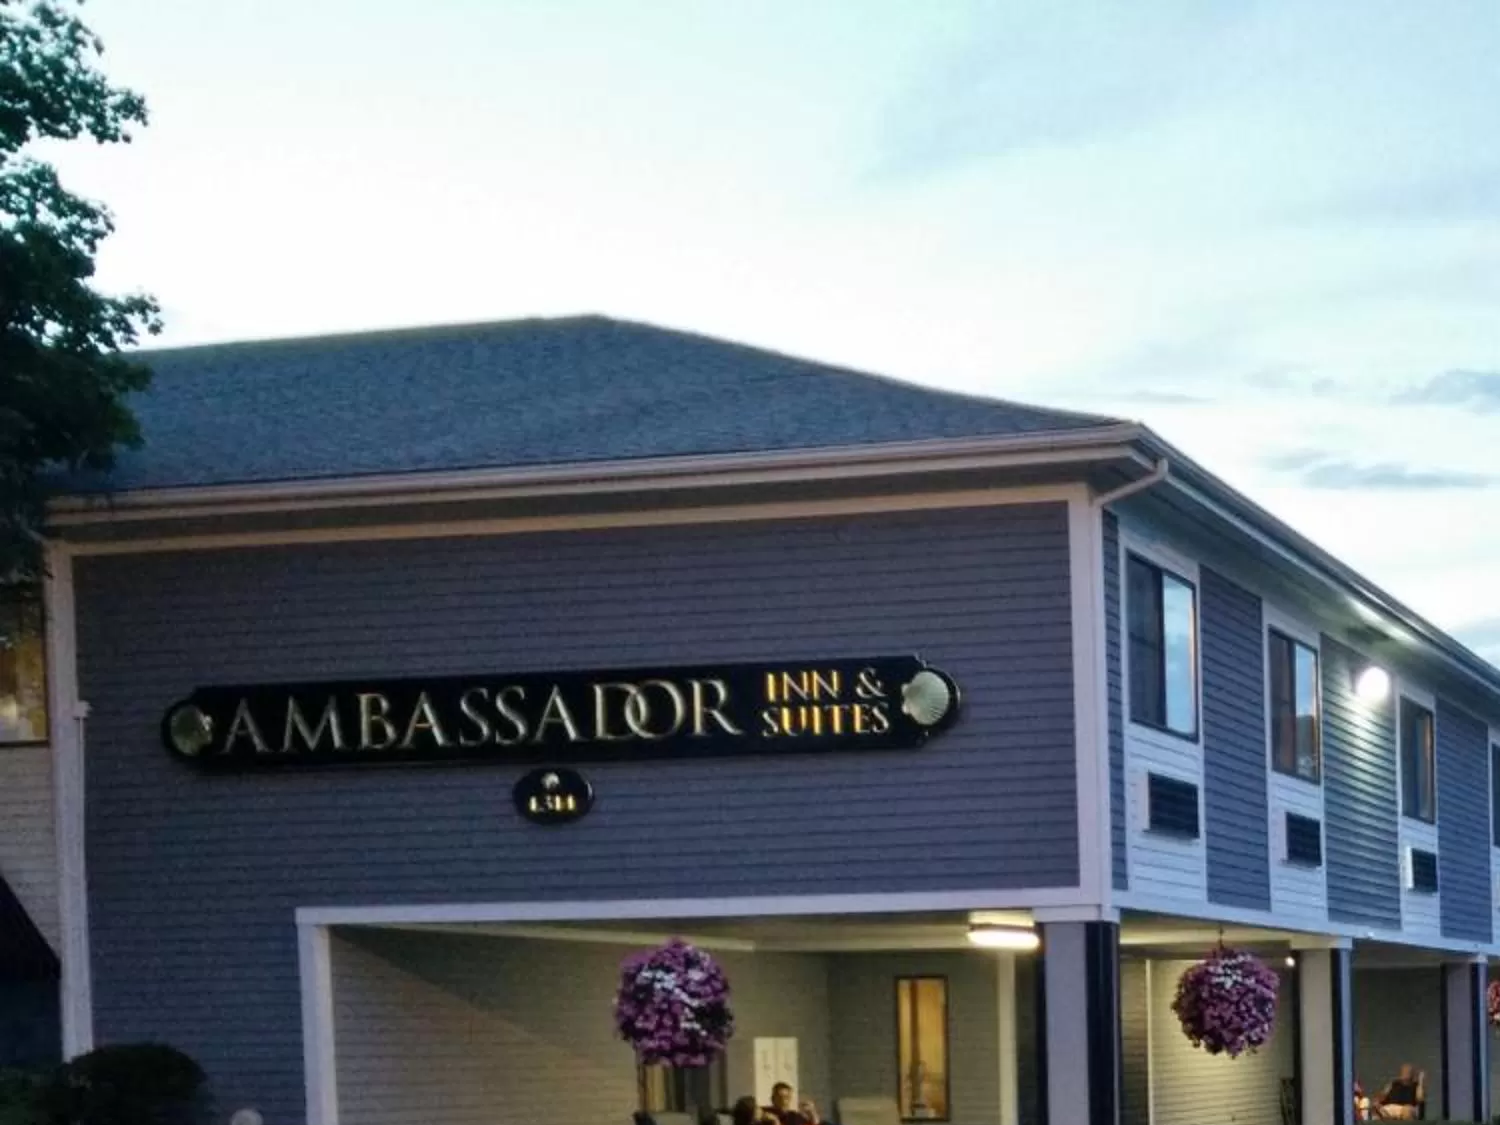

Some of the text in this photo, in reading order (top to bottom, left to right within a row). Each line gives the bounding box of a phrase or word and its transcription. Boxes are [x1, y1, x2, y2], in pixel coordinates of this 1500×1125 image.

[766, 668, 887, 703] INN &
[222, 679, 743, 754] AMBASSADOR
[762, 701, 889, 737] SUITES
